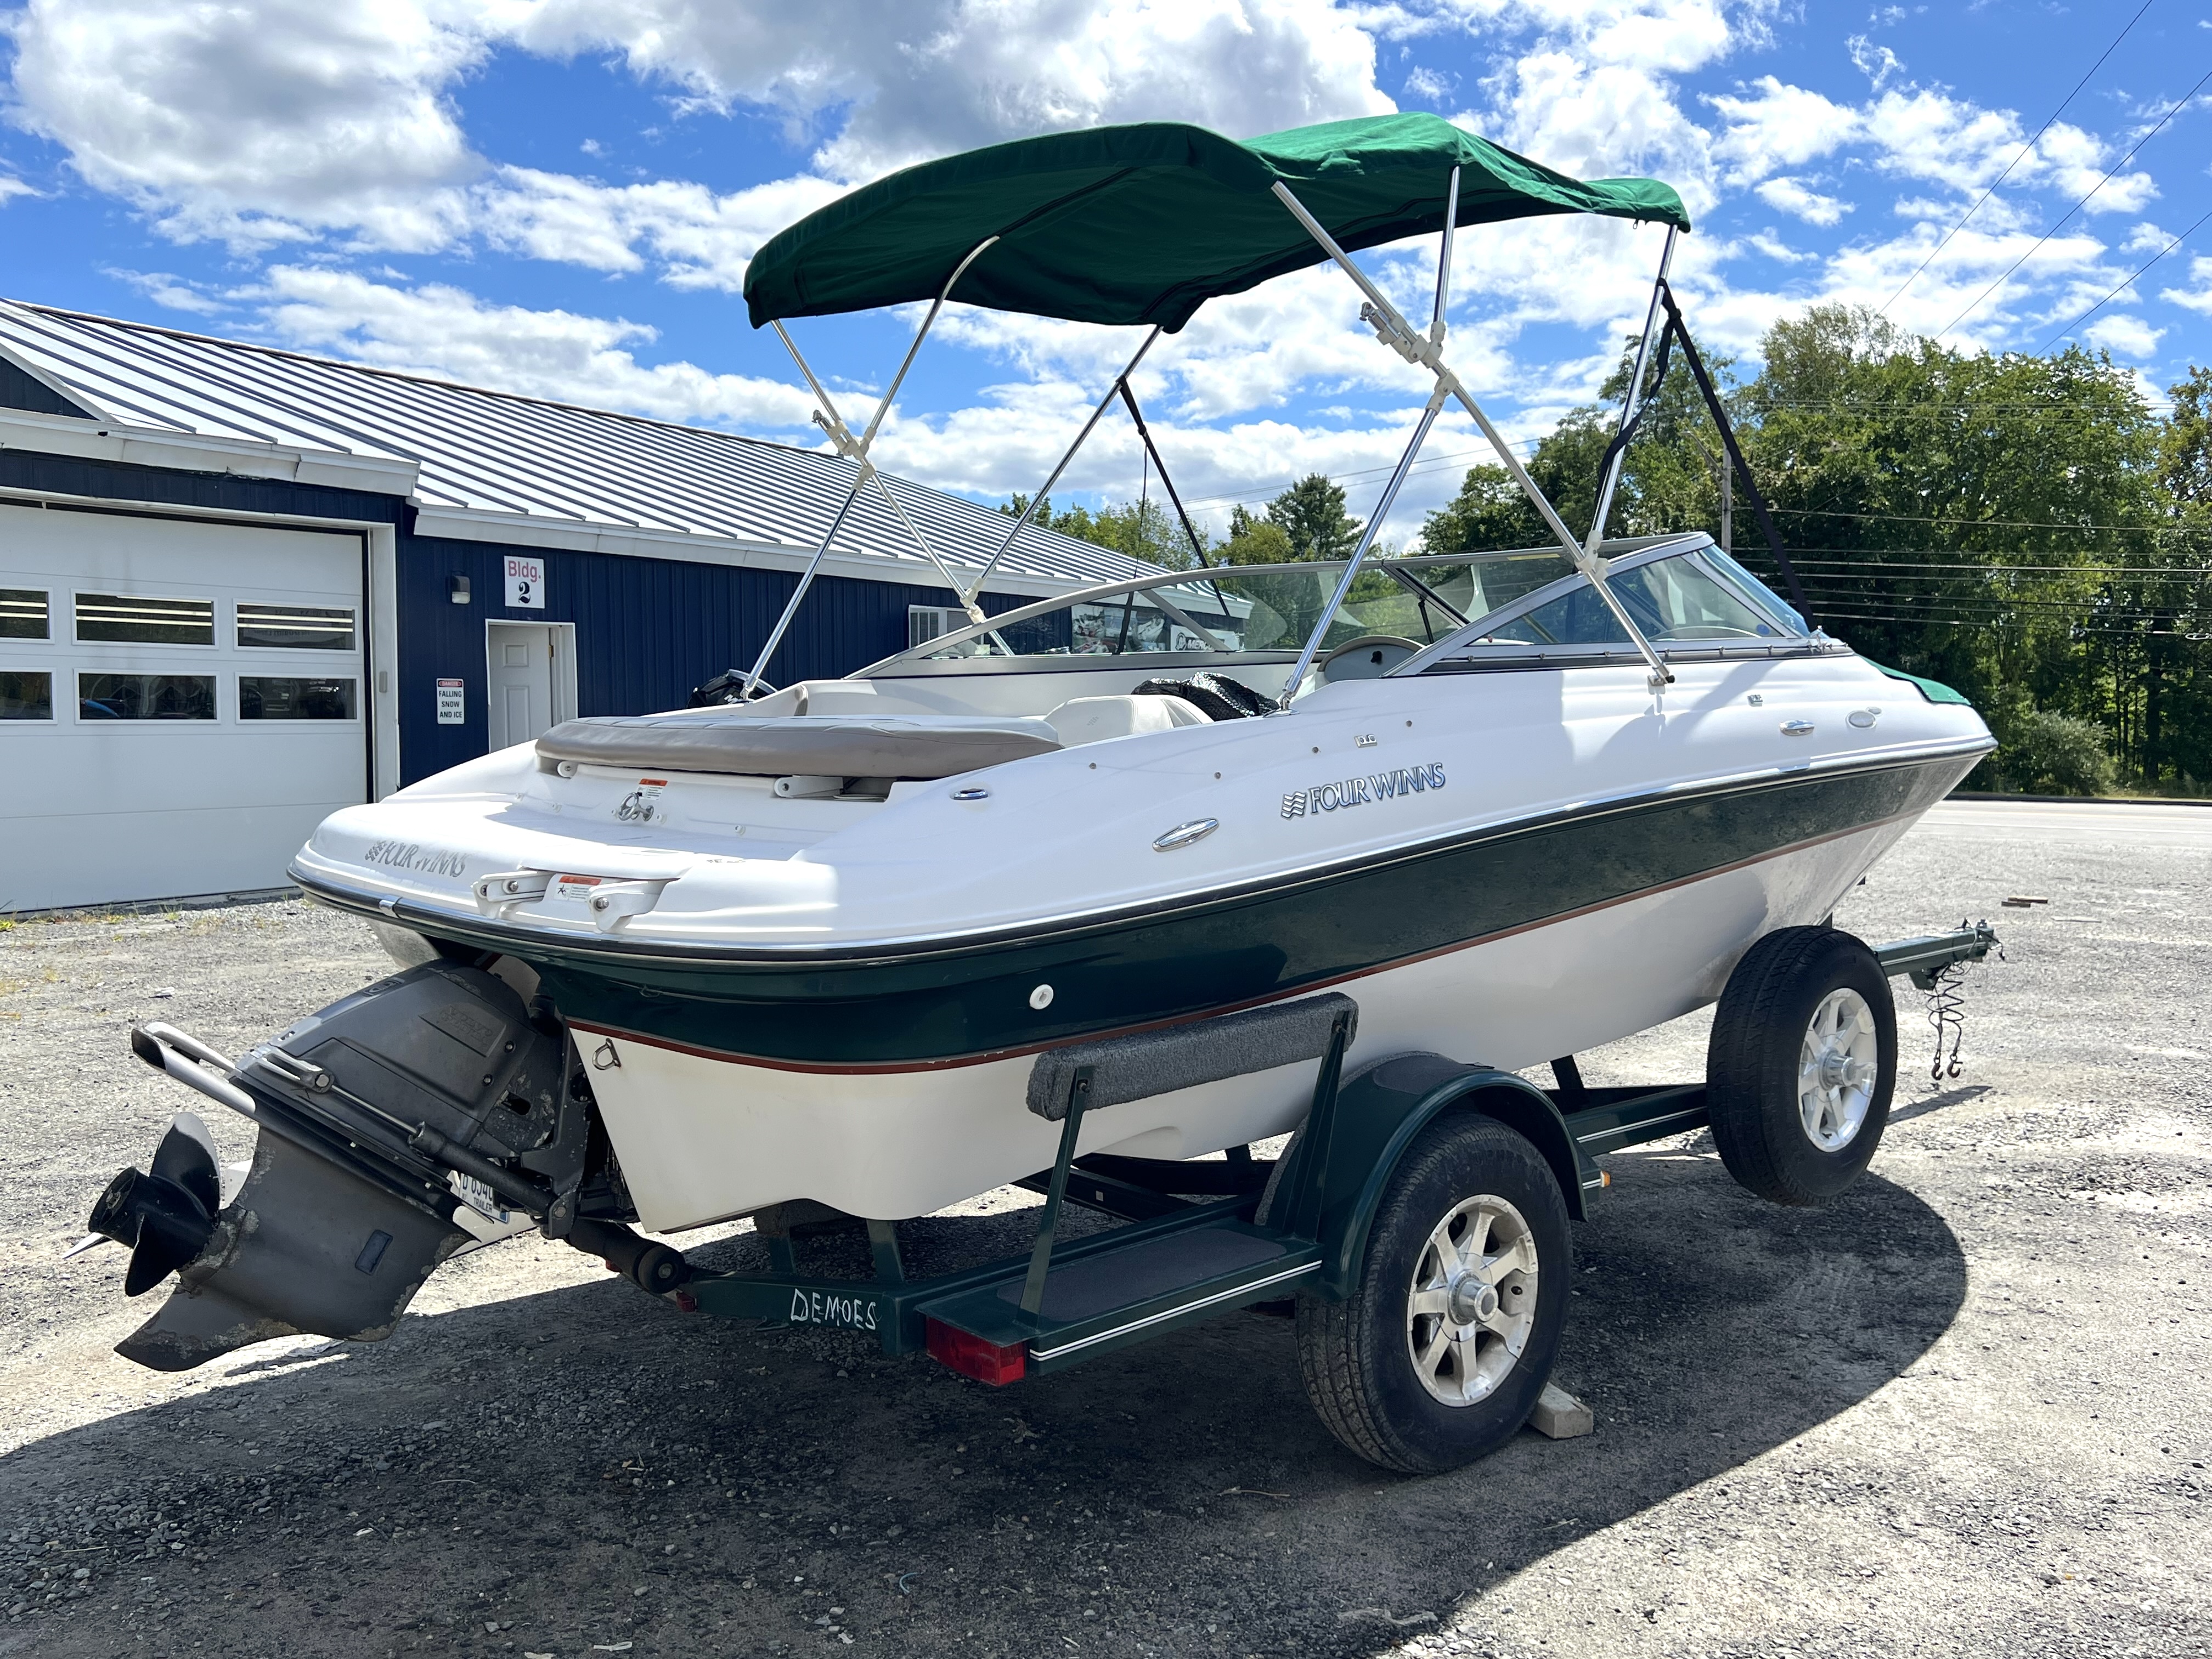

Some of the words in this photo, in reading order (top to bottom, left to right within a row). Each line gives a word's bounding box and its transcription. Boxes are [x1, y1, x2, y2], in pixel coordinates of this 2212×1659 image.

[508, 561, 541, 583] Bldg.
[518, 582, 531, 604] 2
[1308, 777, 1371, 815] FOUR
[1368, 761, 1446, 801] WINNS
[377, 840, 419, 868] FOUR
[414, 849, 472, 878] WINNS
[473, 1197, 493, 1213] TRAILER
[790, 1288, 877, 1330] DEMOES
